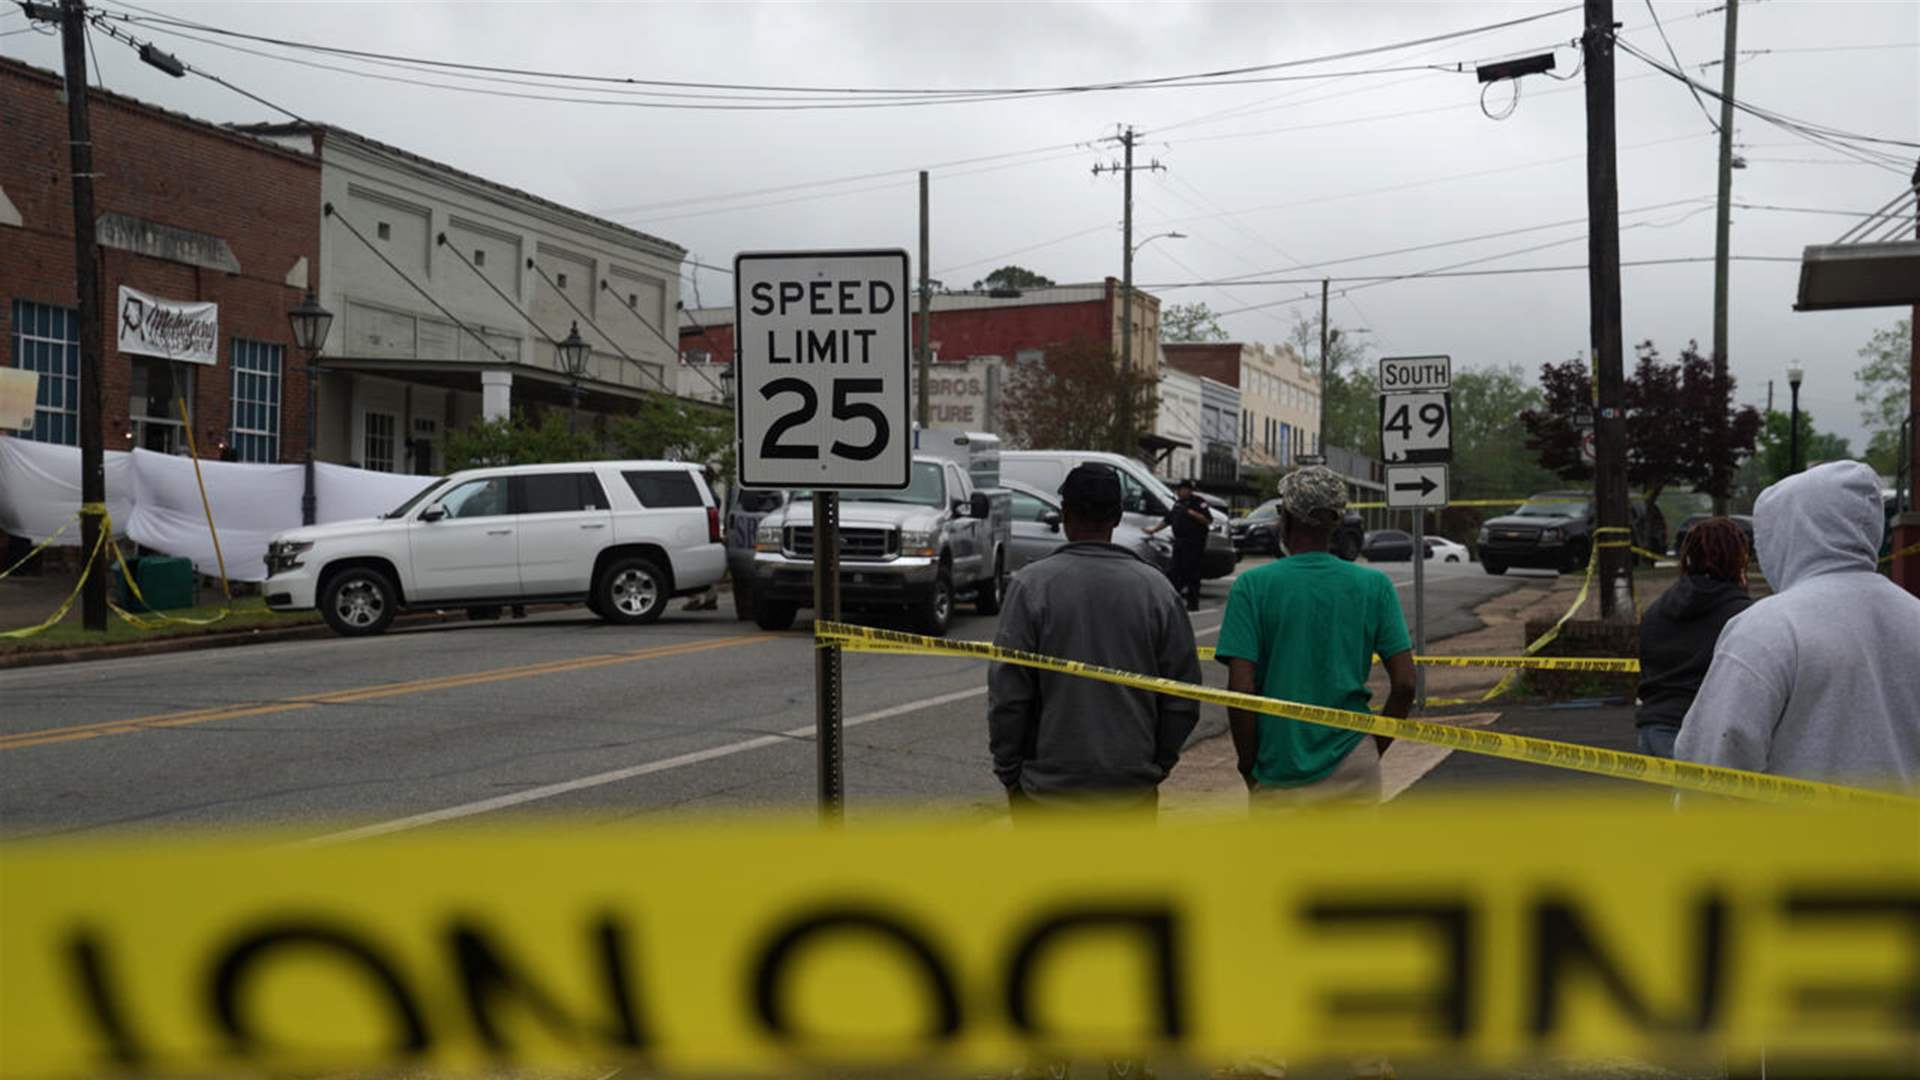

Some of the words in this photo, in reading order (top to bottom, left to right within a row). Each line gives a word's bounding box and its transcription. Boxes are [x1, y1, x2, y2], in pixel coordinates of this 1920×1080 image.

[751, 280, 895, 315] SPEED
[768, 330, 876, 364] LIMIT
[1385, 364, 1447, 386] SOUTH
[759, 378, 890, 461] 25
[1384, 403, 1445, 441] 49
